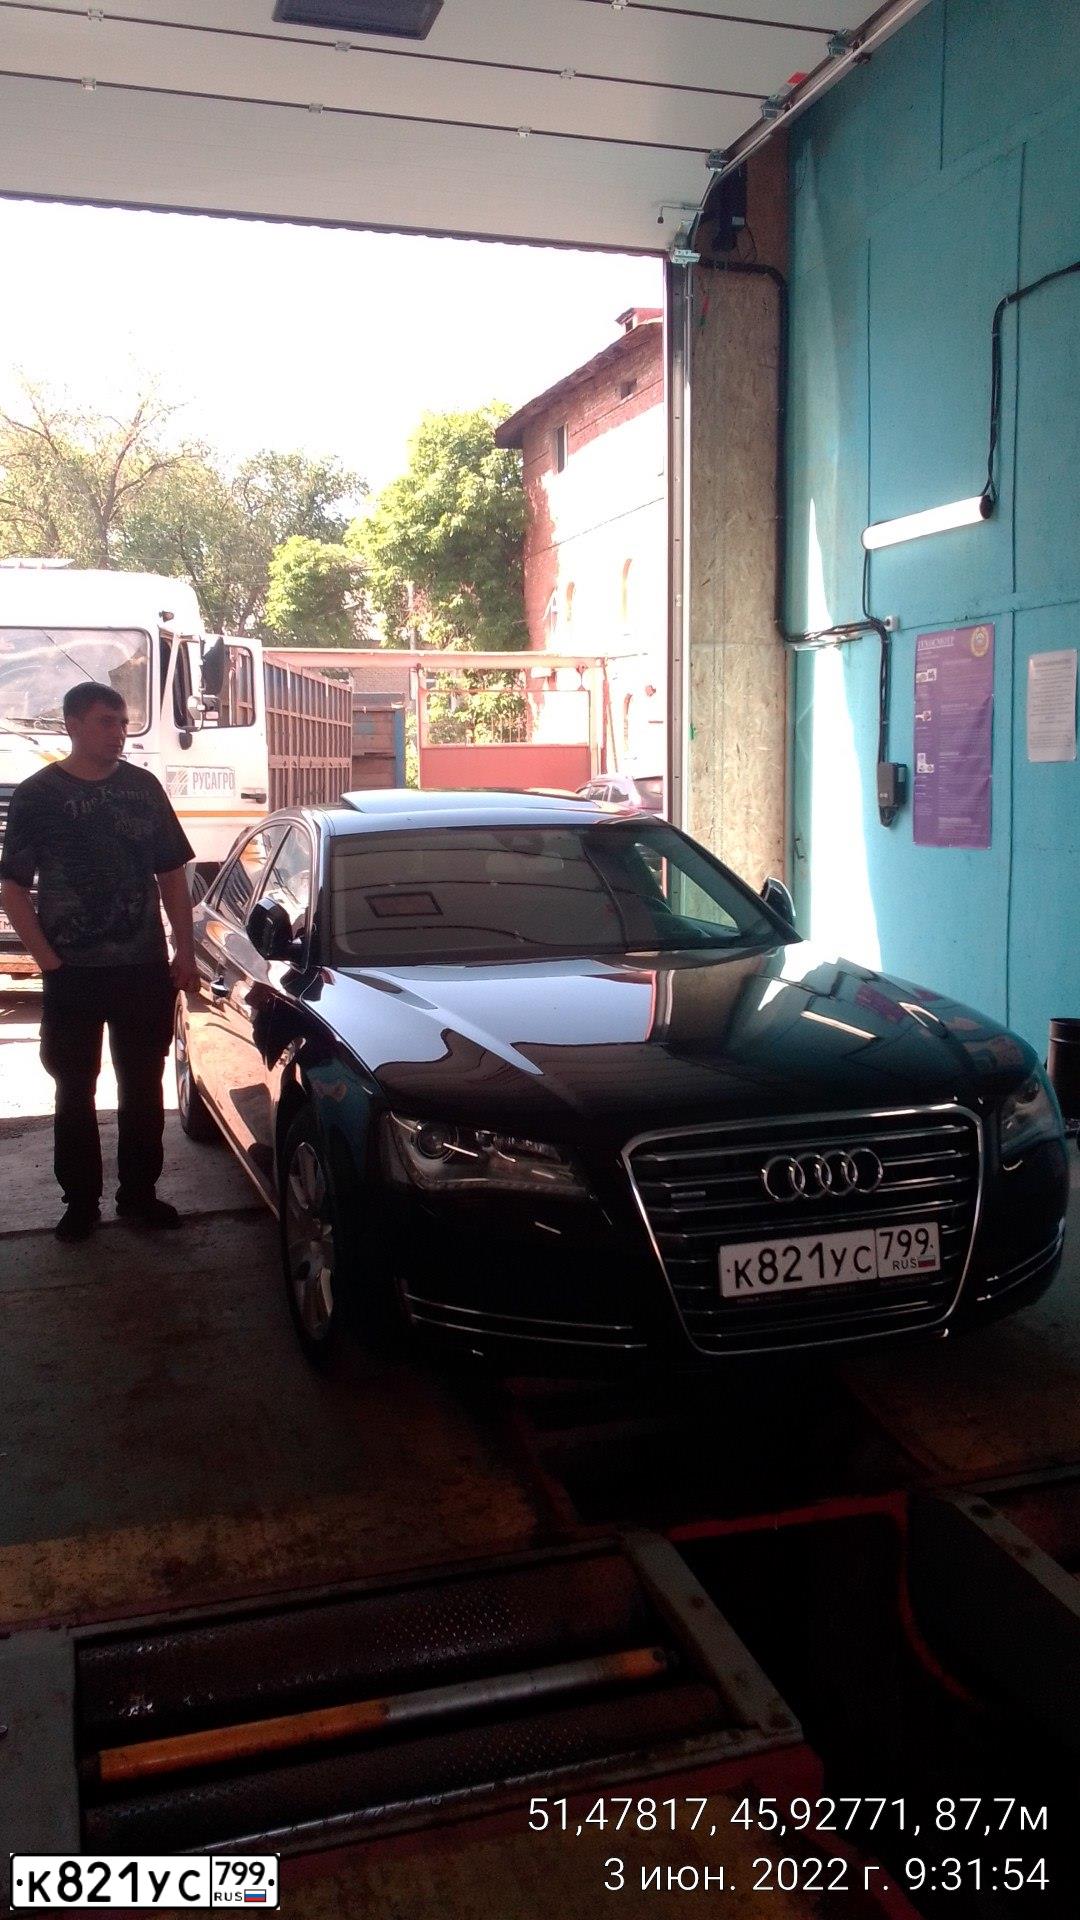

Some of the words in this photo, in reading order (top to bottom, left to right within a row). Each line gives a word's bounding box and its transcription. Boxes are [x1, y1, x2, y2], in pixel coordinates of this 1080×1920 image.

[192, 771, 235, 791] РУСАГРО
[880, 1227, 930, 1260] 799
[892, 1256, 918, 1271] RUS
